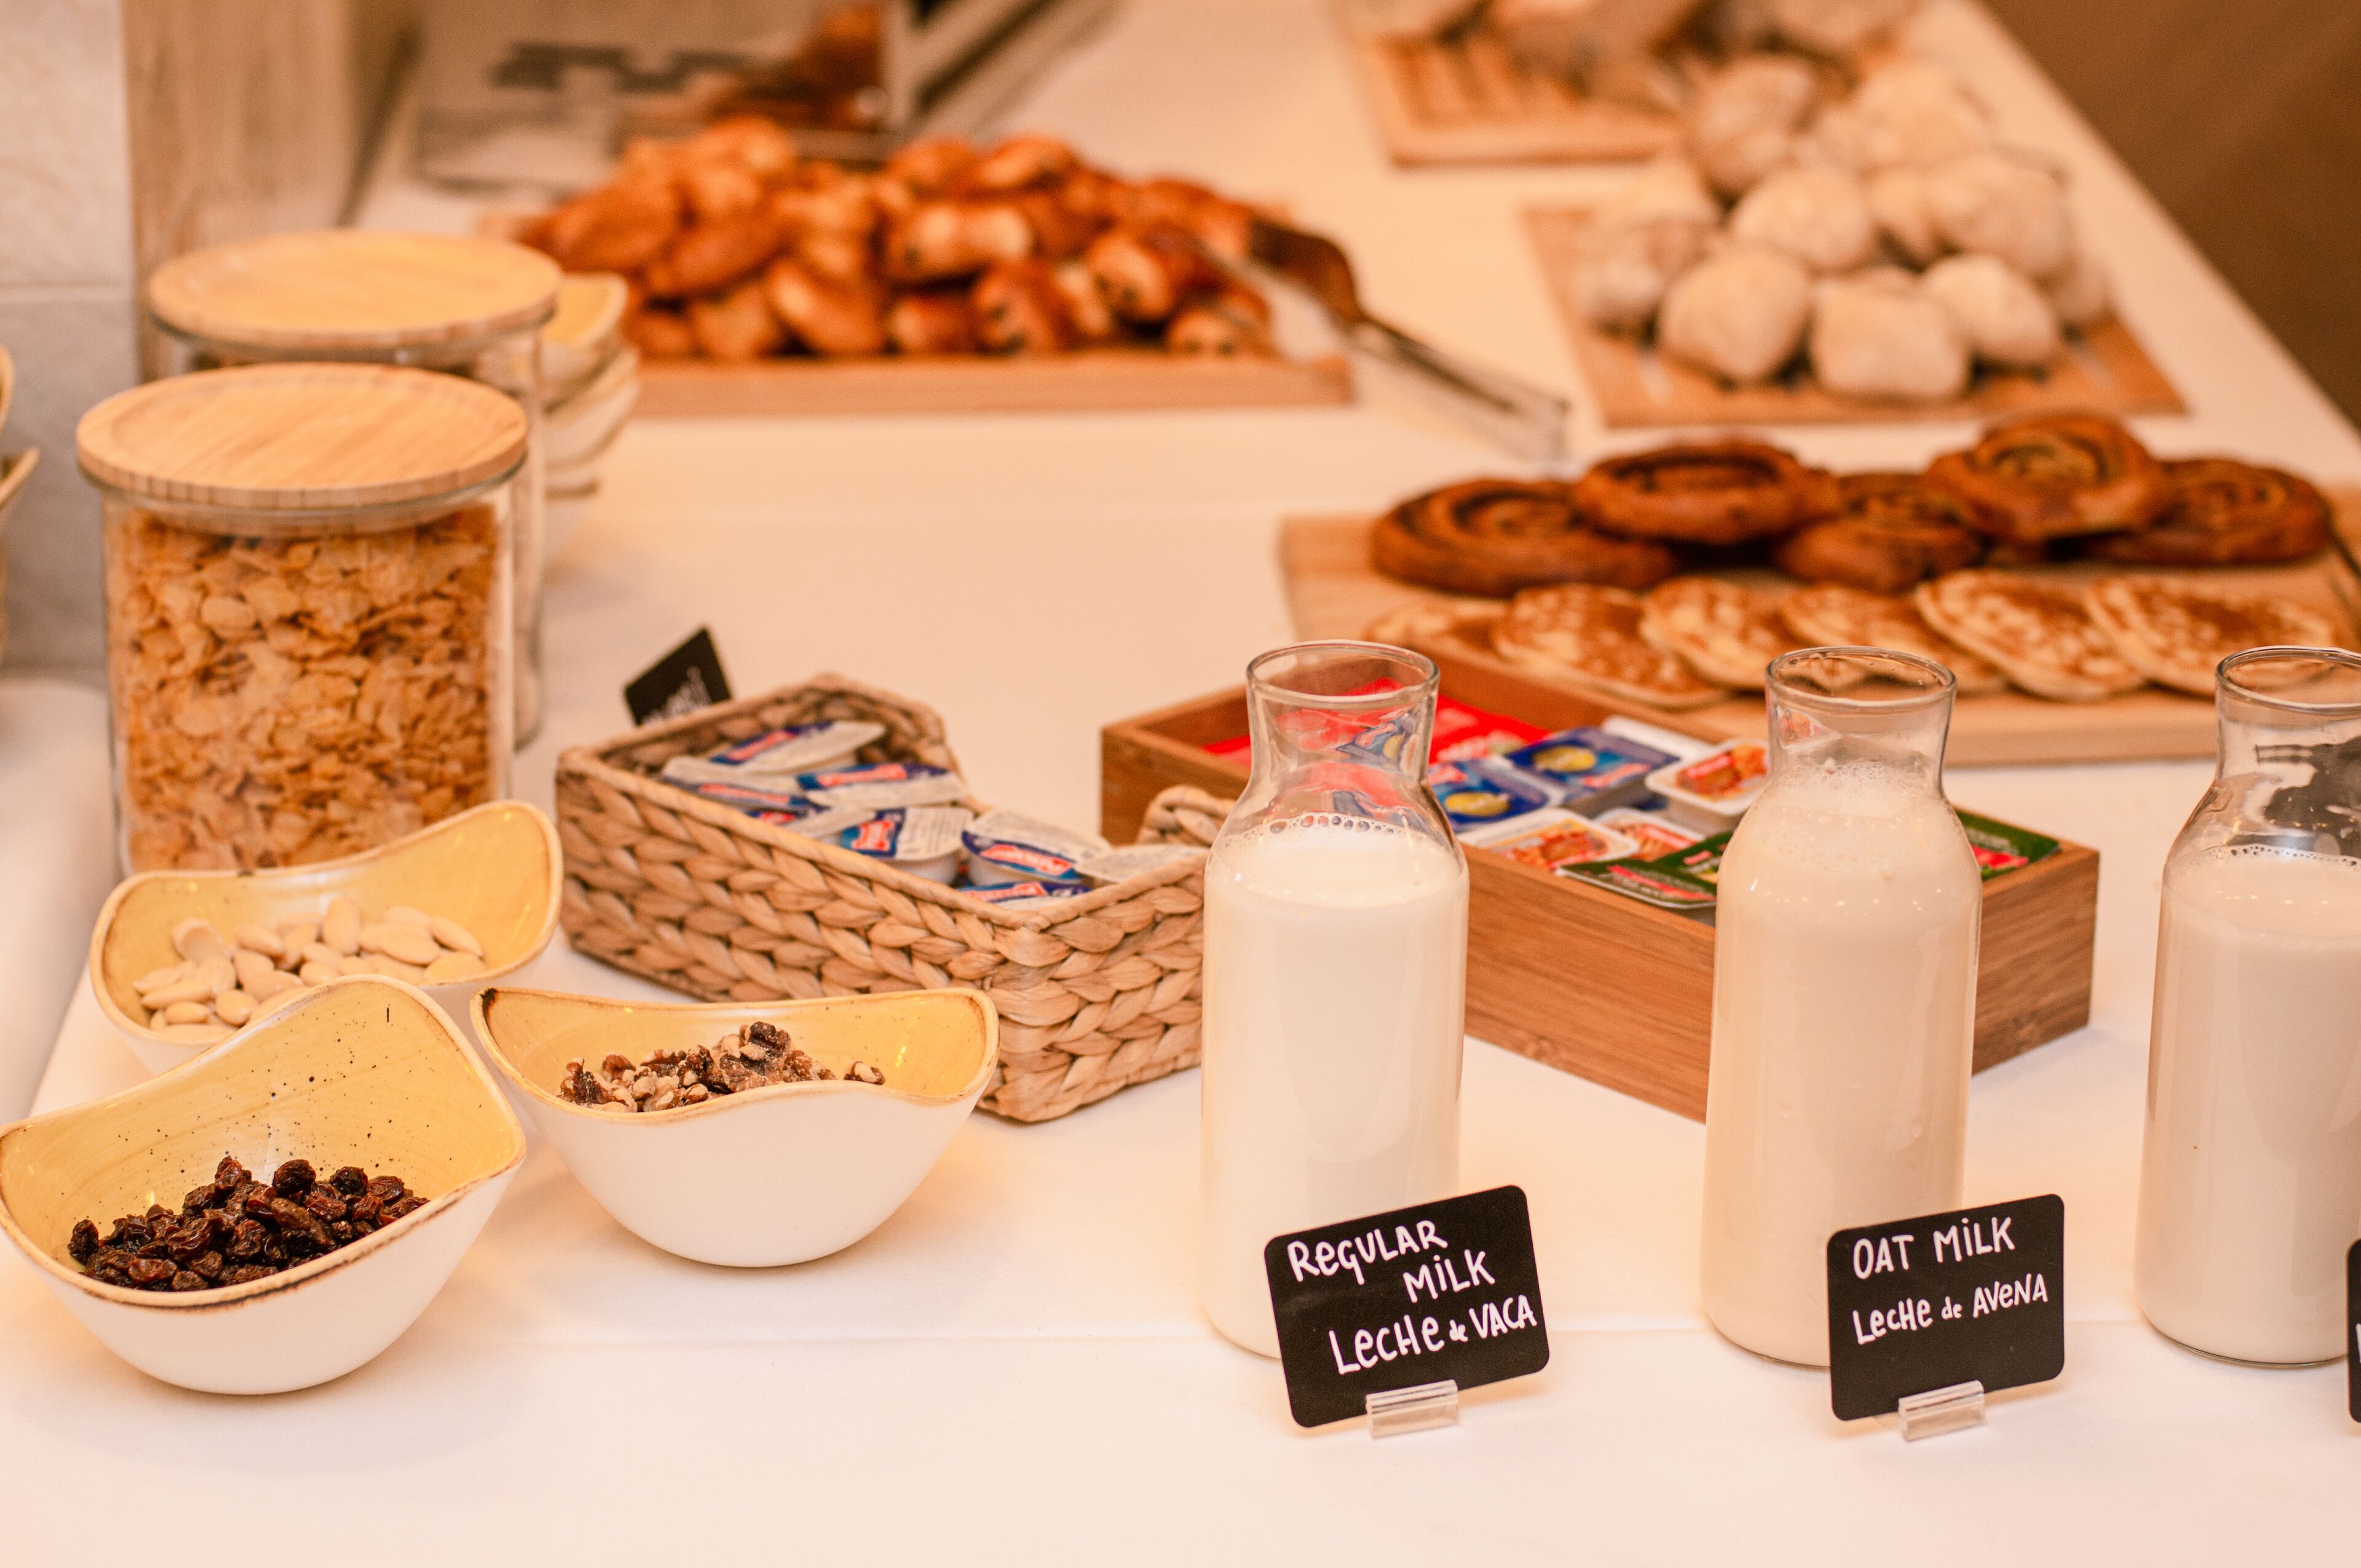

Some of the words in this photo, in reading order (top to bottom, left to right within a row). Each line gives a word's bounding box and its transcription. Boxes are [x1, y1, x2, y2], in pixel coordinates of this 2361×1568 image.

[1853, 1234, 1915, 1280] OAT
[1449, 1319, 1468, 1342] de
[1468, 1294, 1538, 1339] VACA
[1941, 1296, 1963, 1320] de
